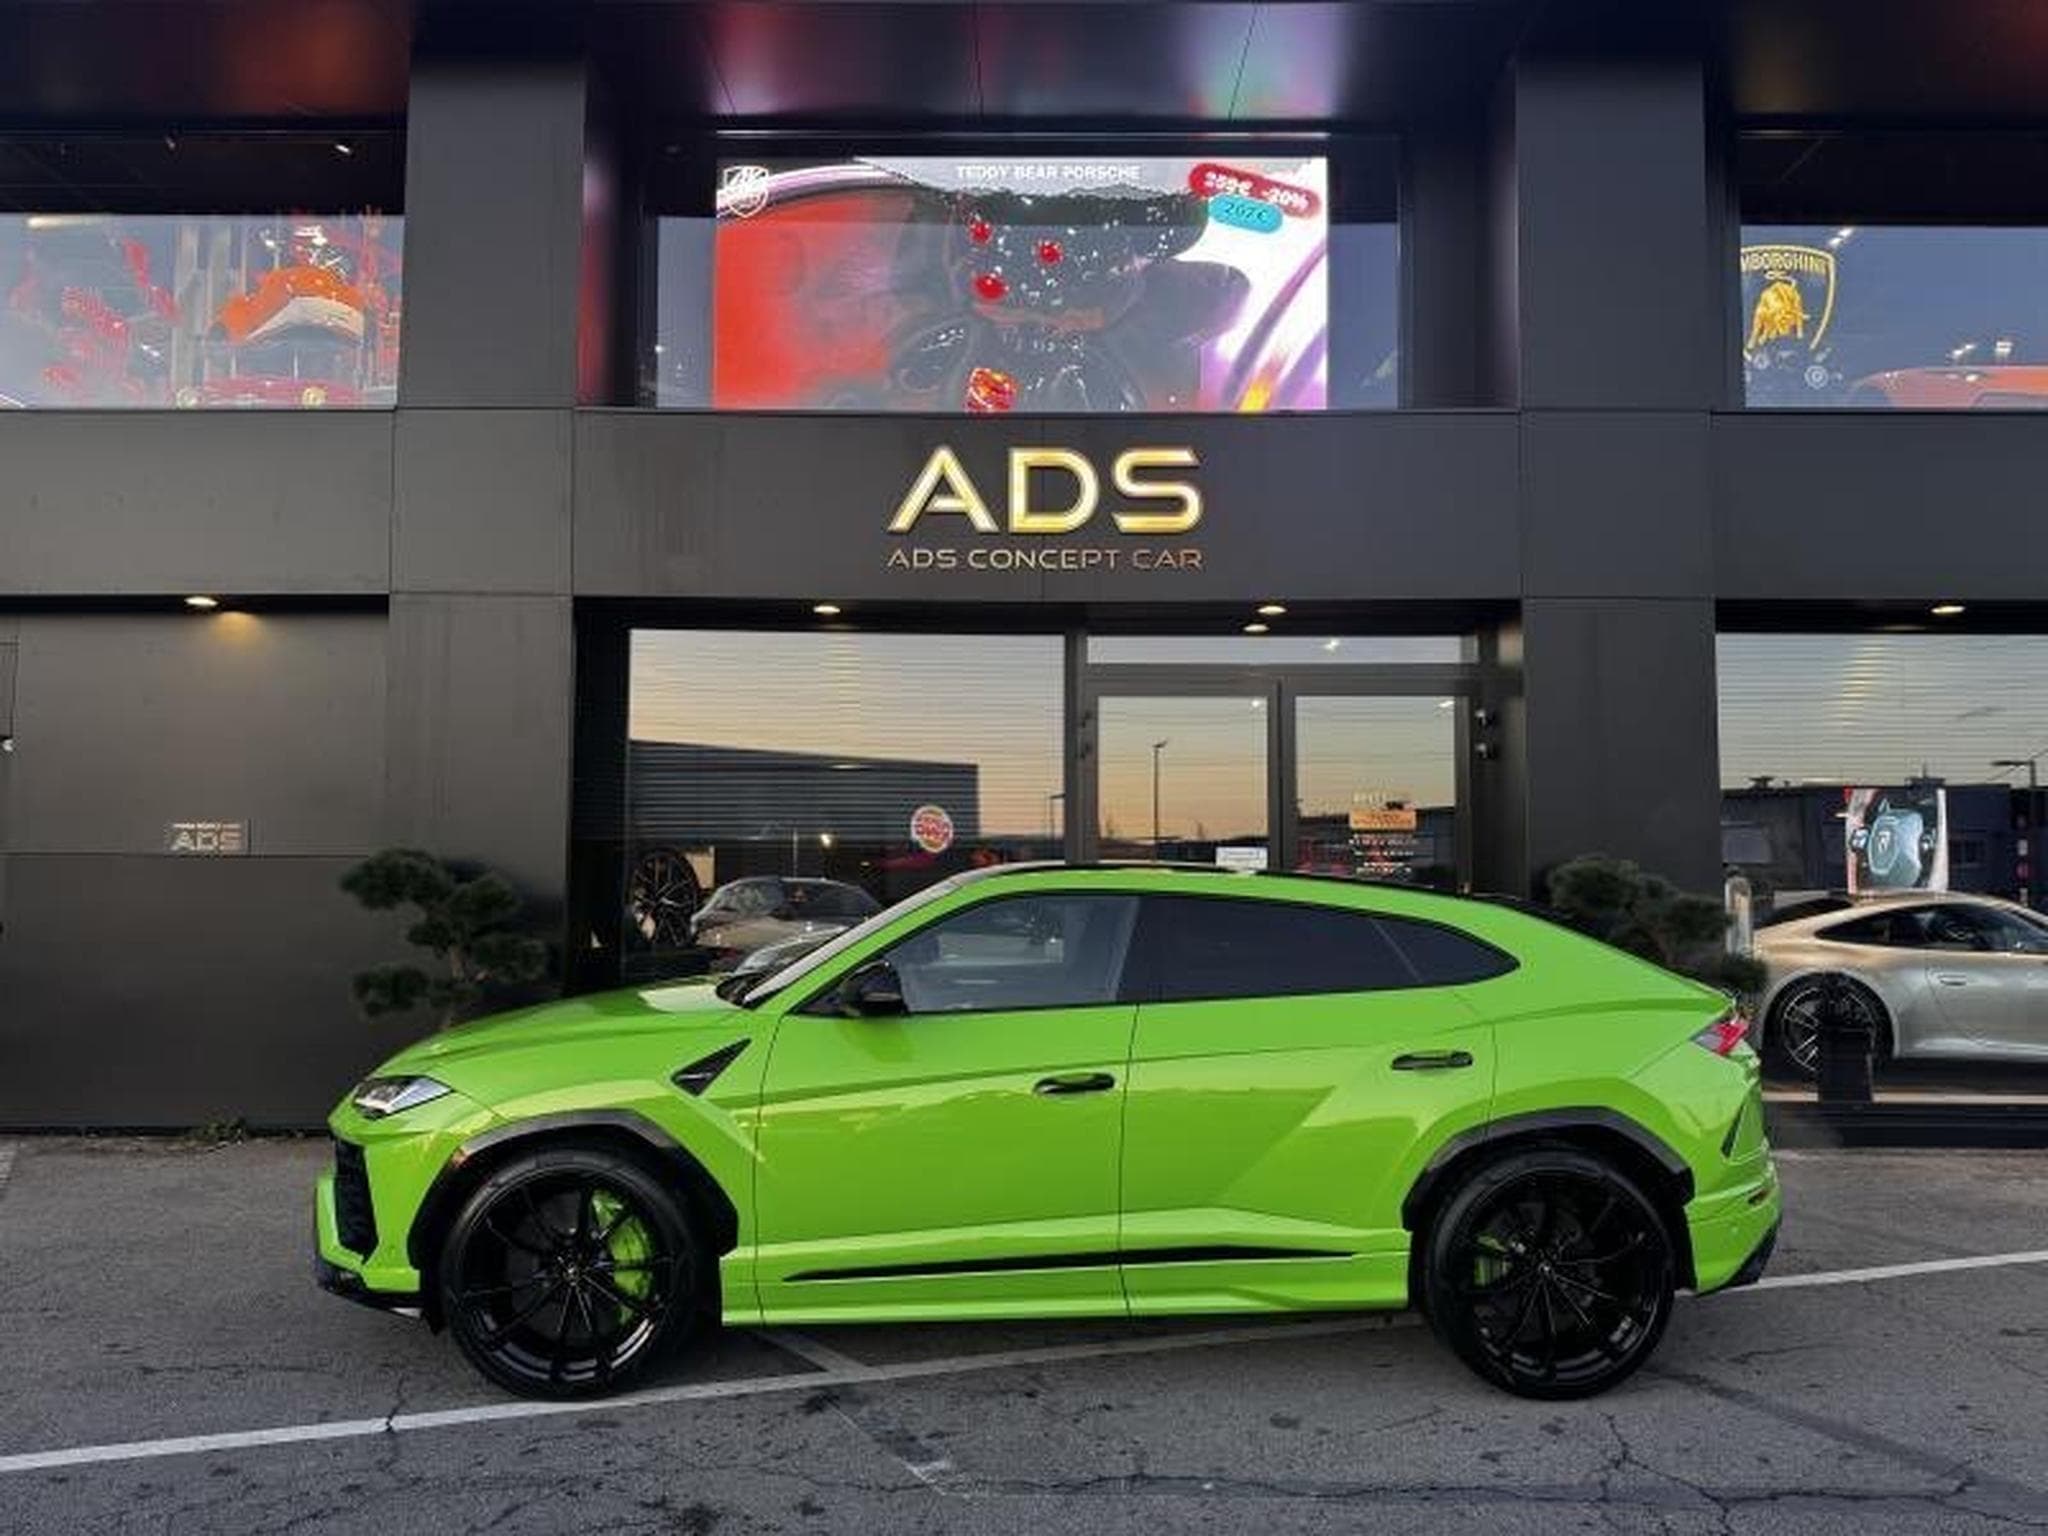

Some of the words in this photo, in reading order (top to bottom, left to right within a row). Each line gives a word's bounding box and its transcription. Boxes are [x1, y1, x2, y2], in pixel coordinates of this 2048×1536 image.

[957, 164, 1010, 180] TEDDY
[1014, 164, 1057, 180] BEAR
[1062, 165, 1141, 181] PORSCHE
[886, 444, 1204, 534] ADS
[886, 548, 958, 570] ADS
[967, 548, 1119, 570] CONCEPT
[1132, 548, 1204, 570] CAR
[170, 831, 241, 852] ADS
